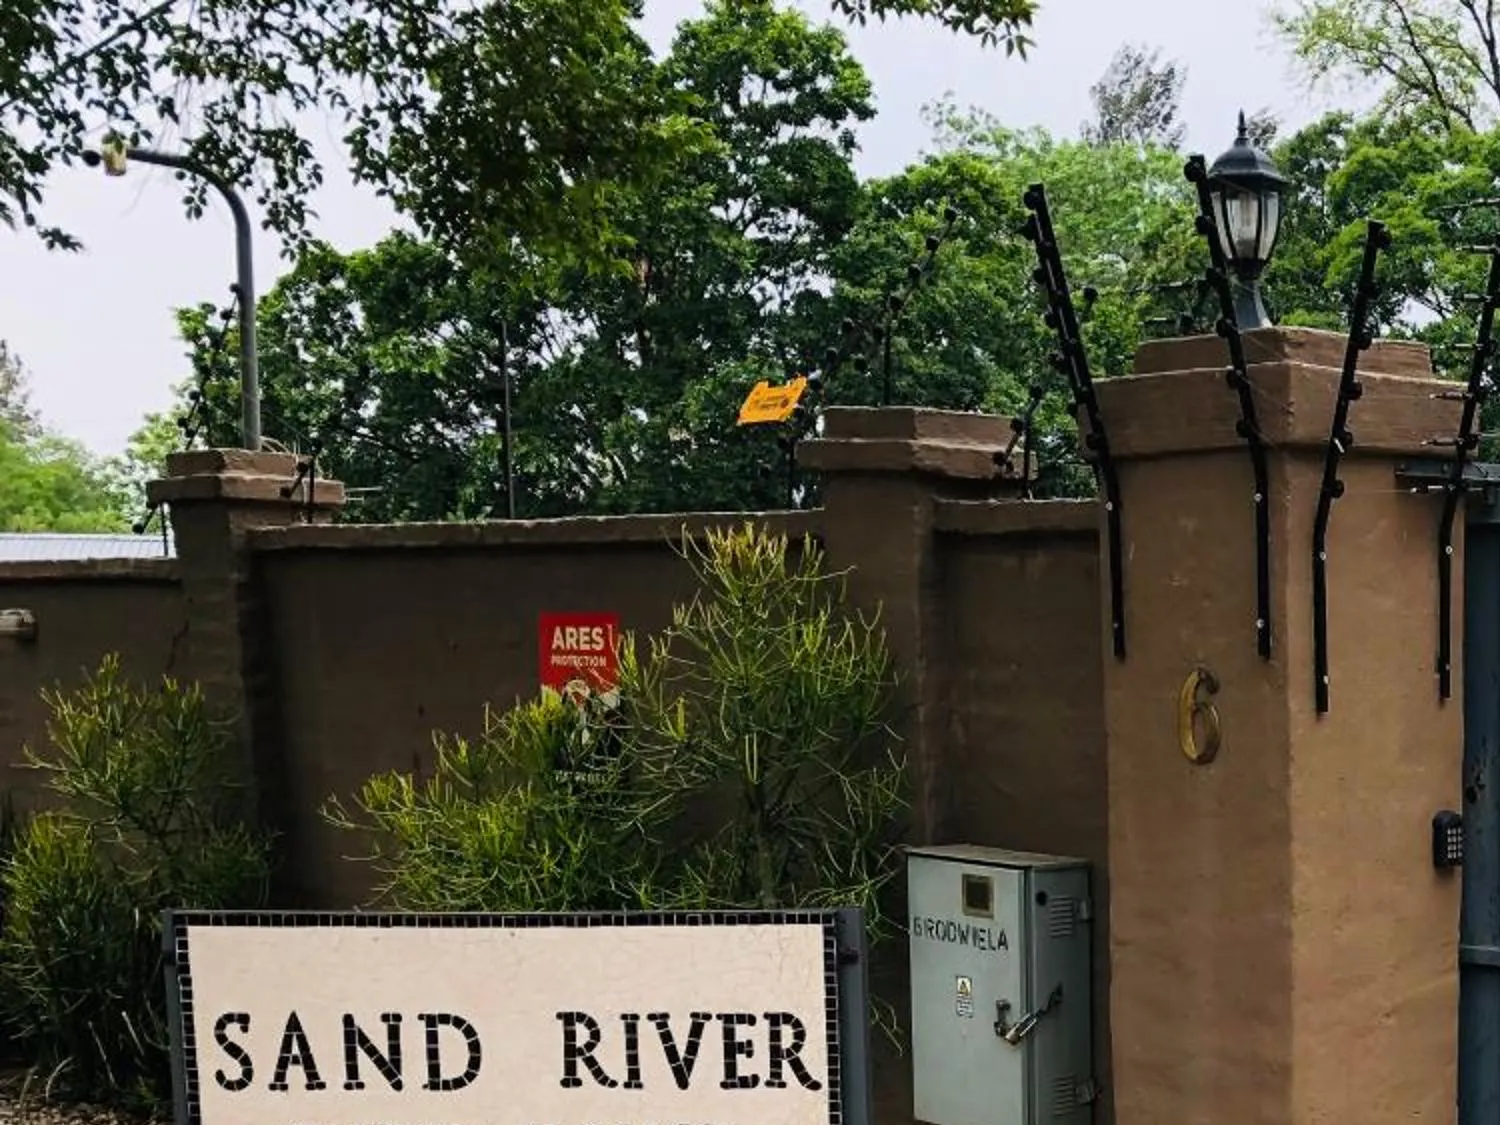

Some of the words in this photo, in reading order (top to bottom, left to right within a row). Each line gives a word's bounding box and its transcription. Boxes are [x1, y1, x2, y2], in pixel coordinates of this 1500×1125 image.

[551, 626, 605, 651] ARES
[551, 655, 607, 667] PROTECTION
[1178, 666, 1222, 766] 6
[213, 1011, 483, 1092] SAND
[555, 1011, 822, 1091] RIVER
